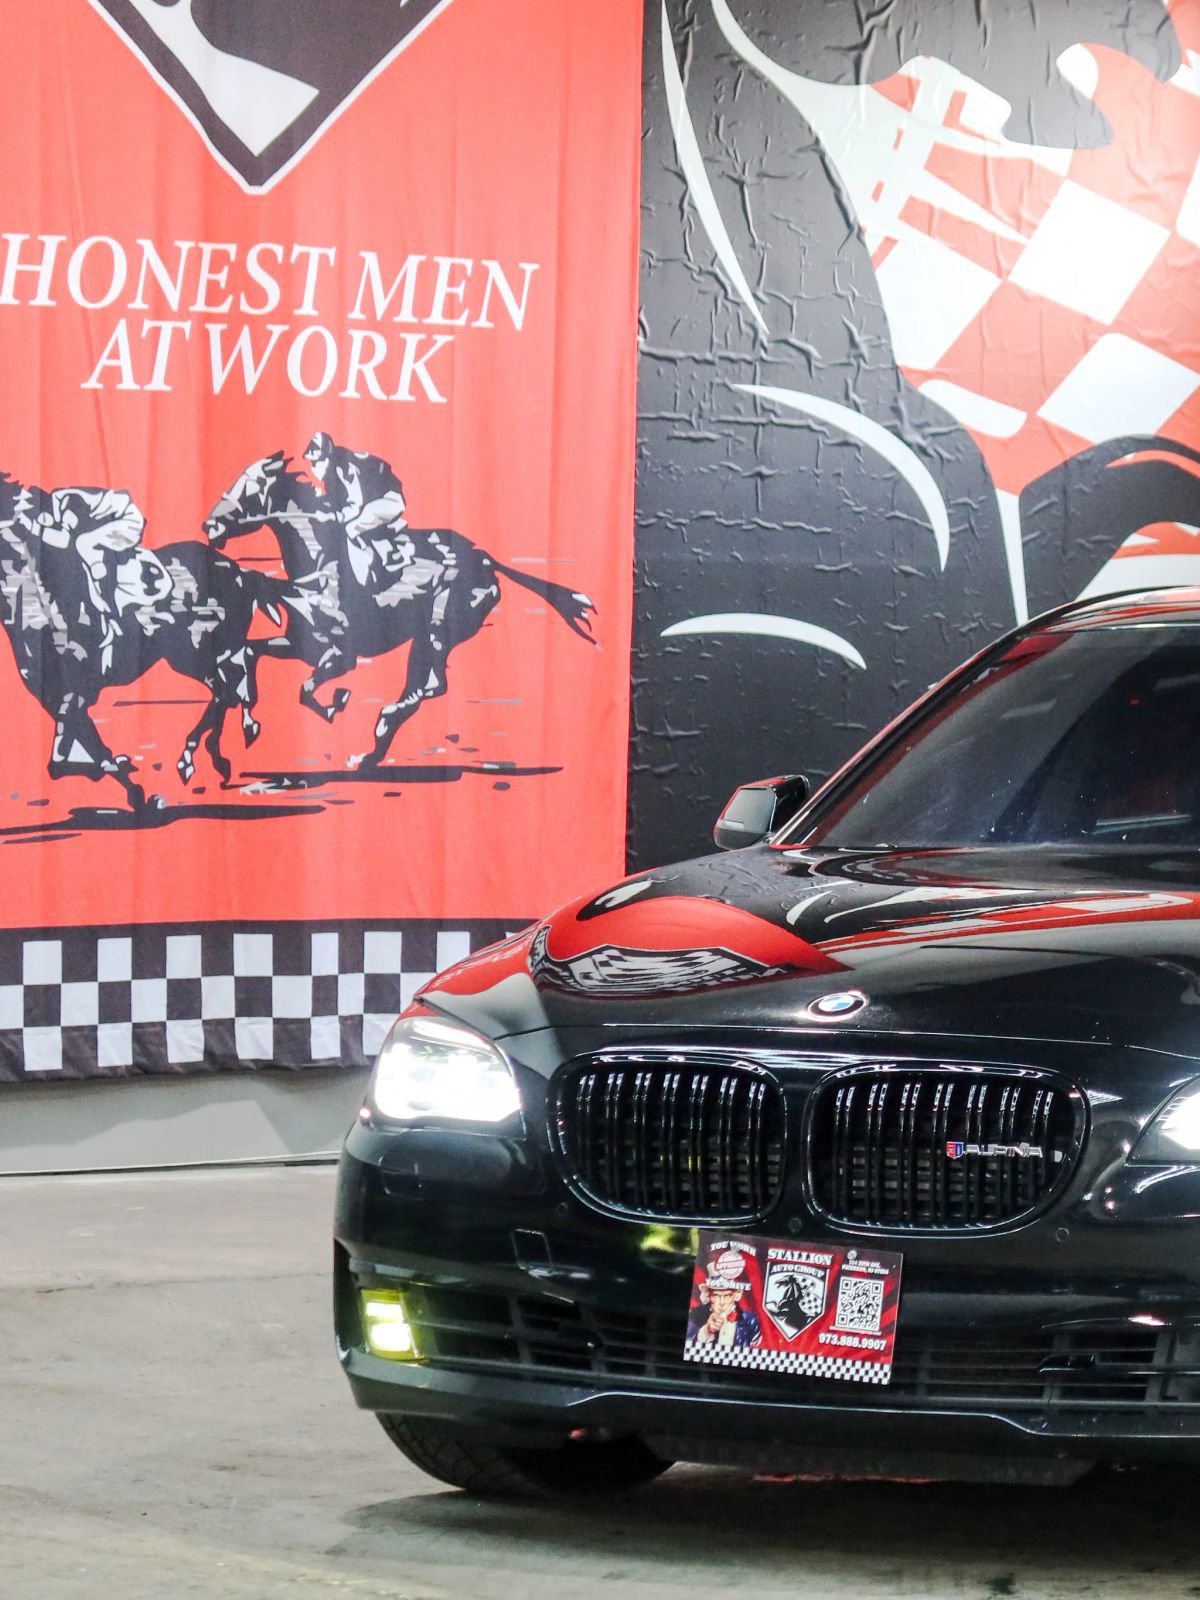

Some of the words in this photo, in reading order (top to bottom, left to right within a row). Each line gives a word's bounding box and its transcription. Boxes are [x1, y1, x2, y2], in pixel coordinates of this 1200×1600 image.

[0, 233, 336, 316] HONEST
[348, 251, 540, 331] MEN
[80, 318, 192, 392] AT
[204, 323, 455, 403] WORK
[767, 1248, 833, 1265] STALLION
[770, 1264, 793, 1274] AUTO
[794, 1264, 826, 1279] GROUP
